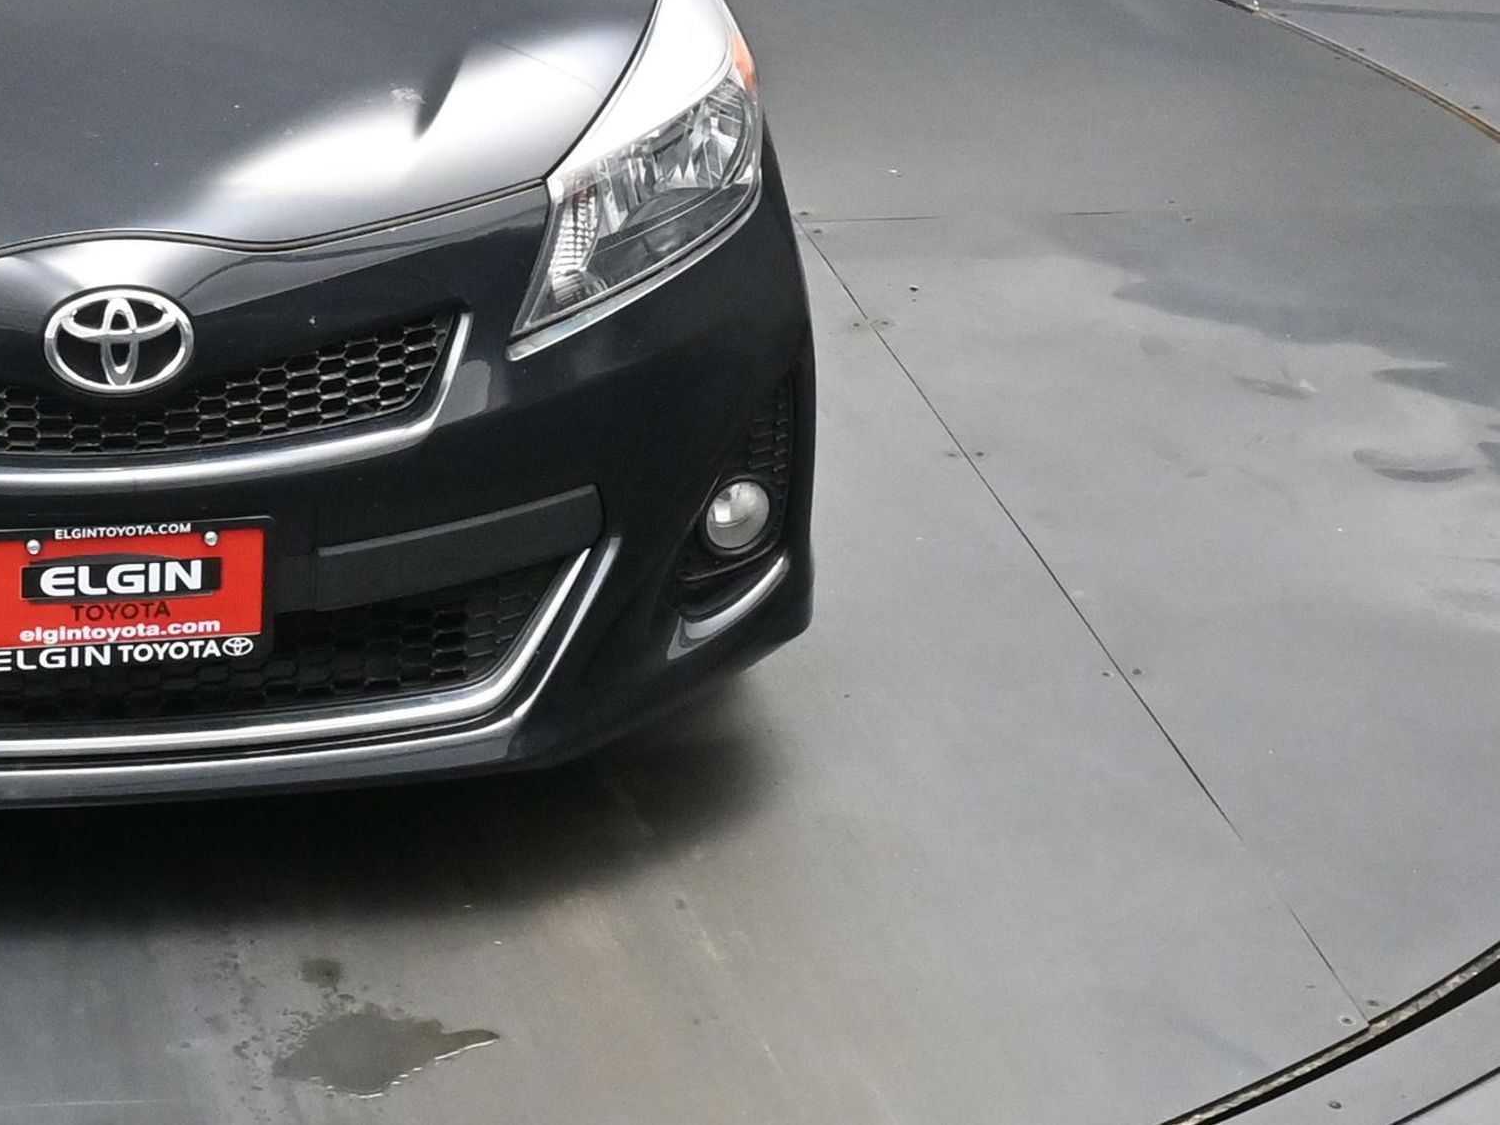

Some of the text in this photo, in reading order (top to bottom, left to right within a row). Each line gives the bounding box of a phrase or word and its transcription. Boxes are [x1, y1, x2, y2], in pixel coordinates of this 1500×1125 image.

[54, 522, 191, 540] ELGINTOYOTA.COM
[40, 559, 202, 597] ELGIN
[70, 601, 171, 622] TOYOTA
[19, 619, 221, 644] elgintoyota.com
[117, 640, 221, 663] TOYOTA
